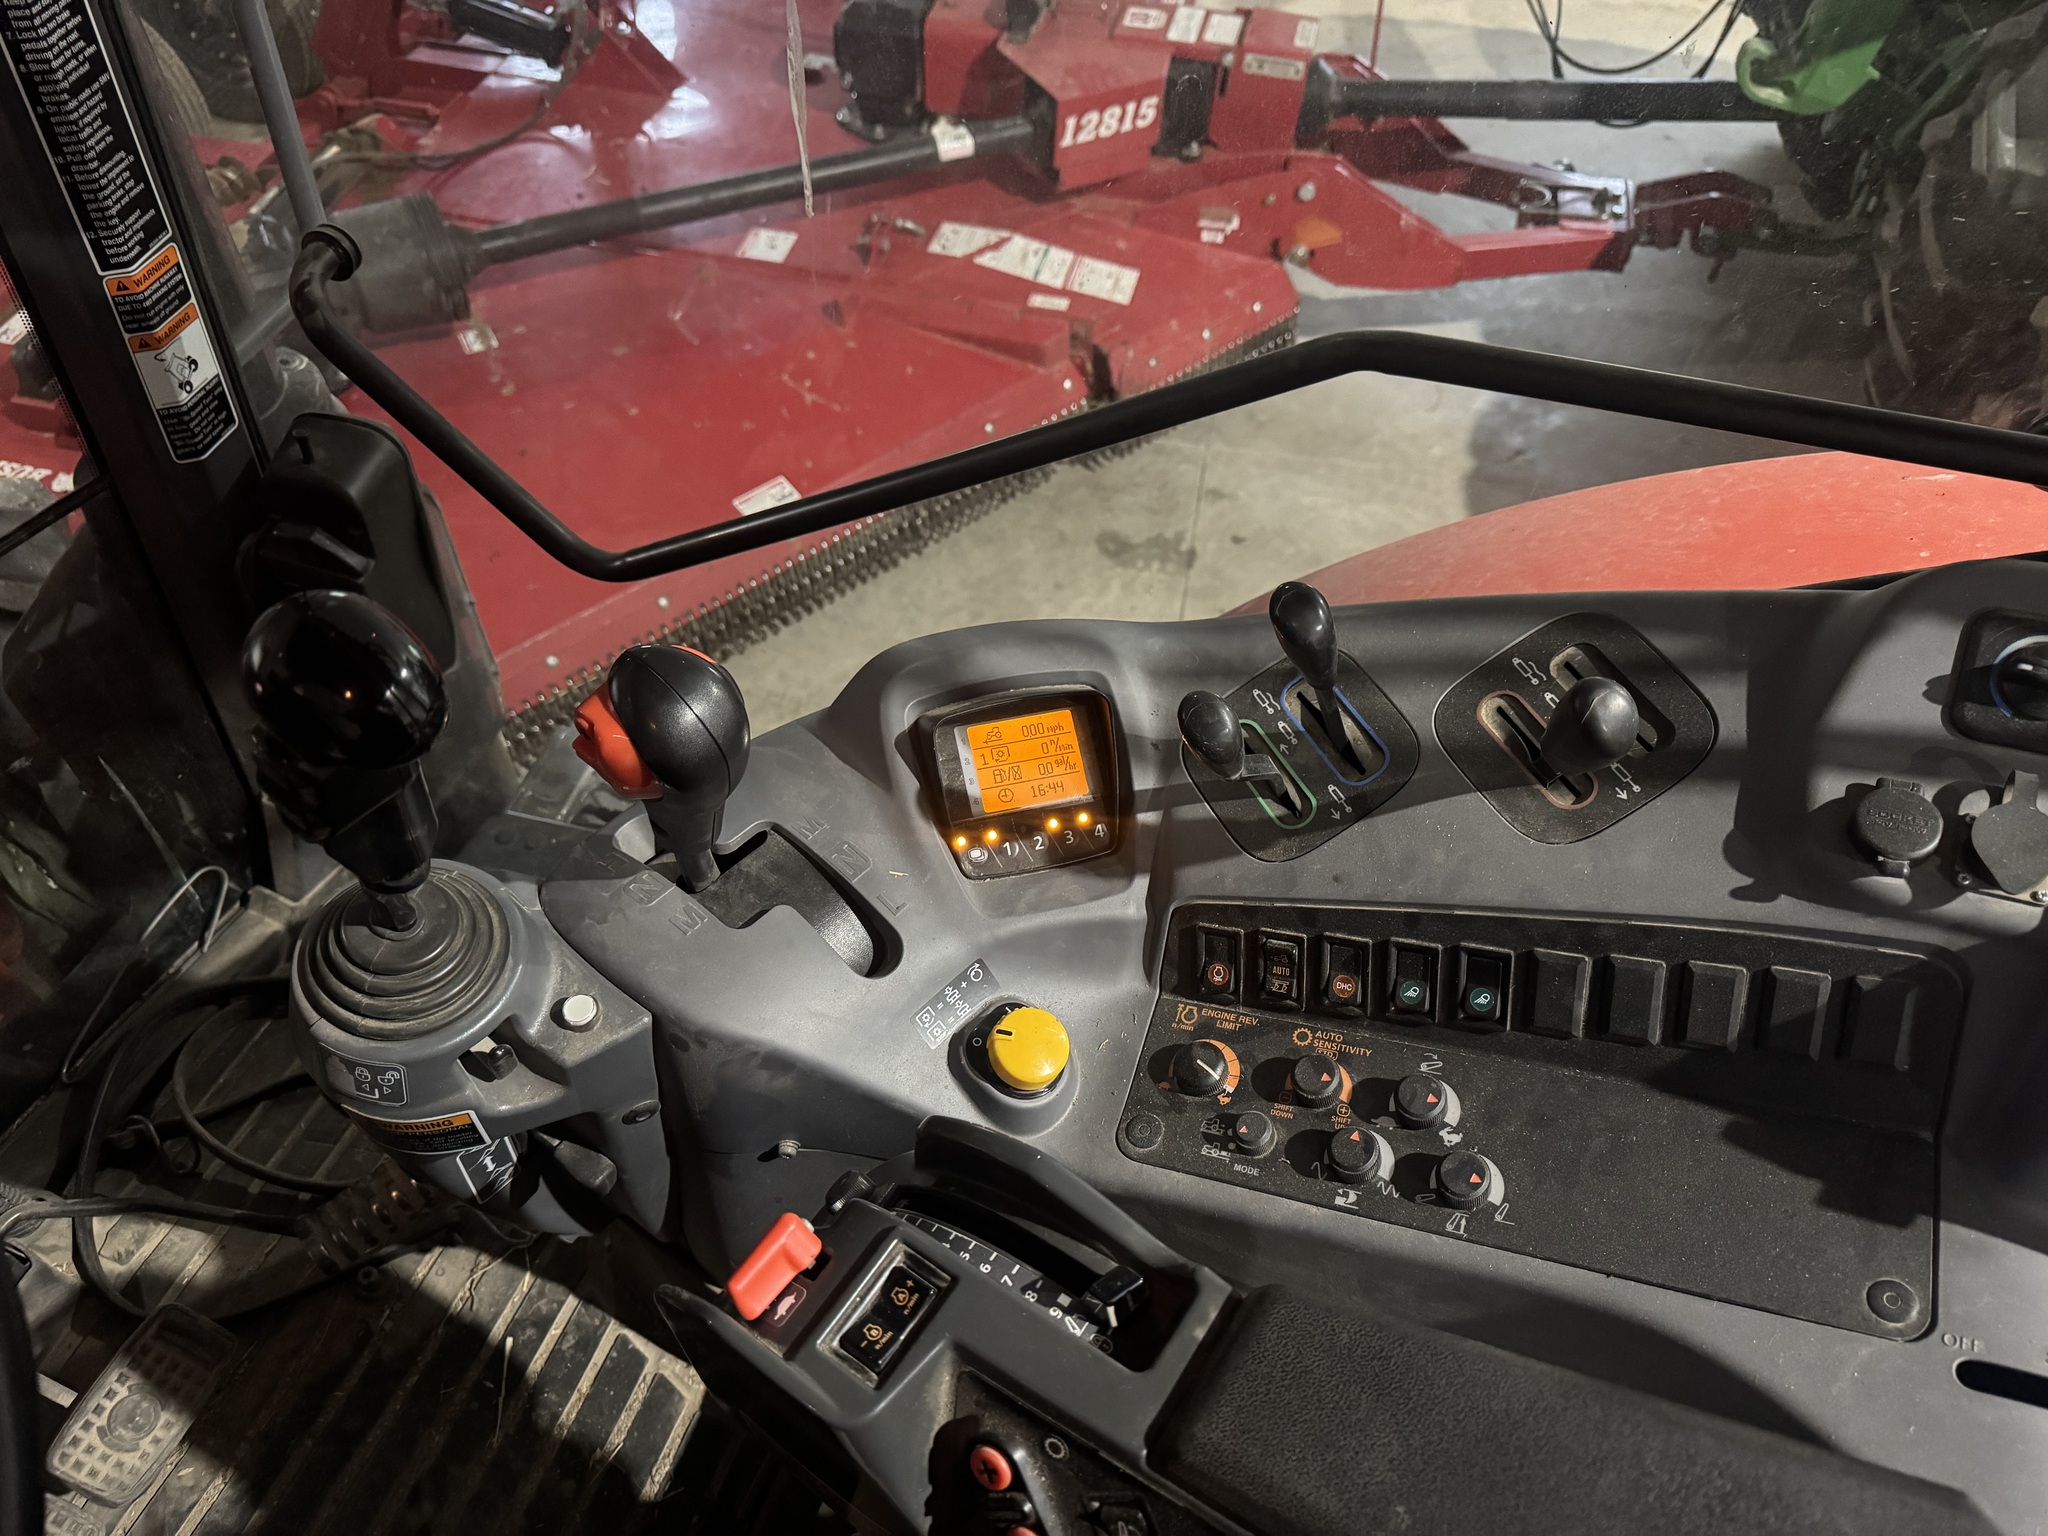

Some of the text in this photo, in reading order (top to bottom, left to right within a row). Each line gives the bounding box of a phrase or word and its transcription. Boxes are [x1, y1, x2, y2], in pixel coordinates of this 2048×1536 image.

[7, 9, 31, 19] place
[12, 19, 33, 28] from
[16, 30, 38, 40] Lock
[38, 26, 48, 37] the
[56, 9, 71, 24] brake
[21, 14, 83, 52] pedals together before
[25, 50, 54, 61] driving
[52, 45, 61, 55] on
[58, 39, 68, 50] the
[29, 62, 50, 72] Slow
[51, 55, 66, 69] down
[44, 68, 65, 81] rough
[46, 104, 59, 113] On
[60, 98, 79, 113] public
[78, 87, 92, 102] roads
[90, 81, 101, 92] use
[78, 102, 89, 116] and
[86, 89, 103, 108] hazard
[99, 100, 109, 111] by
[92, 116, 103, 130] and
[1058, 95, 1160, 149] 12815
[83, 148, 98, 161] only
[74, 171, 100, 181] Before
[99, 176, 109, 187] the
[85, 198, 113, 211] parking
[120, 193, 131, 206] and
[101, 234, 126, 246] tractor
[124, 226, 134, 240] and
[105, 243, 129, 255] before
[132, 254, 171, 289] WARNING
[114, 296, 124, 304] TO
[125, 291, 146, 302] AVOID
[154, 311, 192, 345] WARNING
[1030, 780, 1065, 798] 16:44
[1063, 830, 1074, 844] 3
[1094, 824, 1105, 838] 4
[1003, 841, 1012, 856] 1
[1033, 835, 1045, 850] 2
[1272, 965, 1290, 977] AUTO
[1336, 981, 1353, 991] DHC
[1201, 1008, 1260, 1026] ENGINE REV.
[1171, 1022, 1194, 1032] n/min
[1216, 1020, 1241, 1031] LIMIT
[1314, 1030, 1344, 1042] AUTO
[1313, 1039, 1373, 1057] SENSITIVITY
[1273, 1103, 1294, 1112] SHIFT
[1270, 1109, 1294, 1120] DOWN
[1331, 1115, 1352, 1125] SHIFT
[1233, 1163, 1260, 1177] MODE
[979, 1262, 992, 1274] 6
[1000, 1275, 1014, 1287] 7
[1024, 1289, 1038, 1302] 8
[903, 1293, 920, 1315] n/min
[874, 1331, 894, 1350] n/min
[1941, 1332, 1985, 1354] OFF
